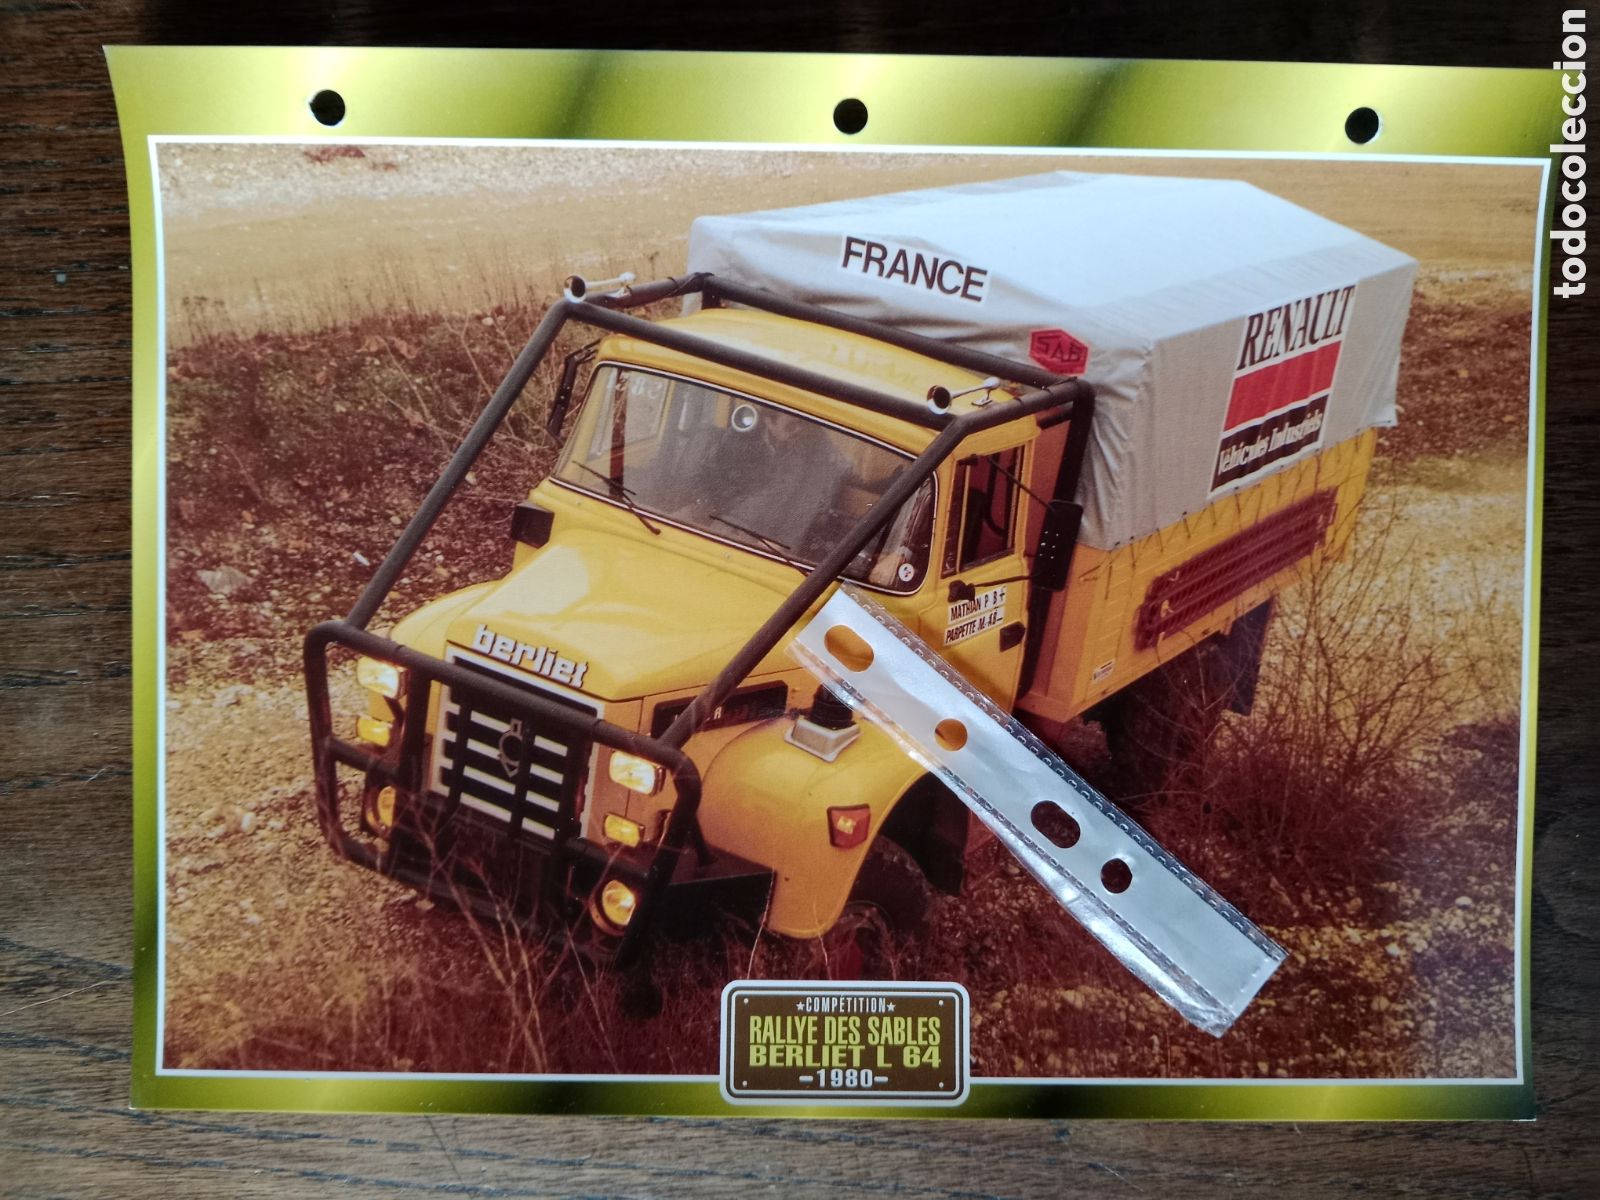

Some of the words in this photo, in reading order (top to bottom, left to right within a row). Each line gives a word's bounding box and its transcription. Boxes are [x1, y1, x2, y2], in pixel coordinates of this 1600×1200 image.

[841, 235, 988, 303] FRANCE
[1236, 285, 1356, 370] RENAULT
[470, 624, 589, 688] berliet
[806, 994, 886, 1013] COMPÉTITION
[750, 1015, 817, 1044] RALLYE
[824, 1015, 861, 1044] DES
[868, 1016, 940, 1045] SABLES
[749, 1045, 865, 1068] BERLIET
[877, 1046, 892, 1068] L
[903, 1046, 941, 1068] 64
